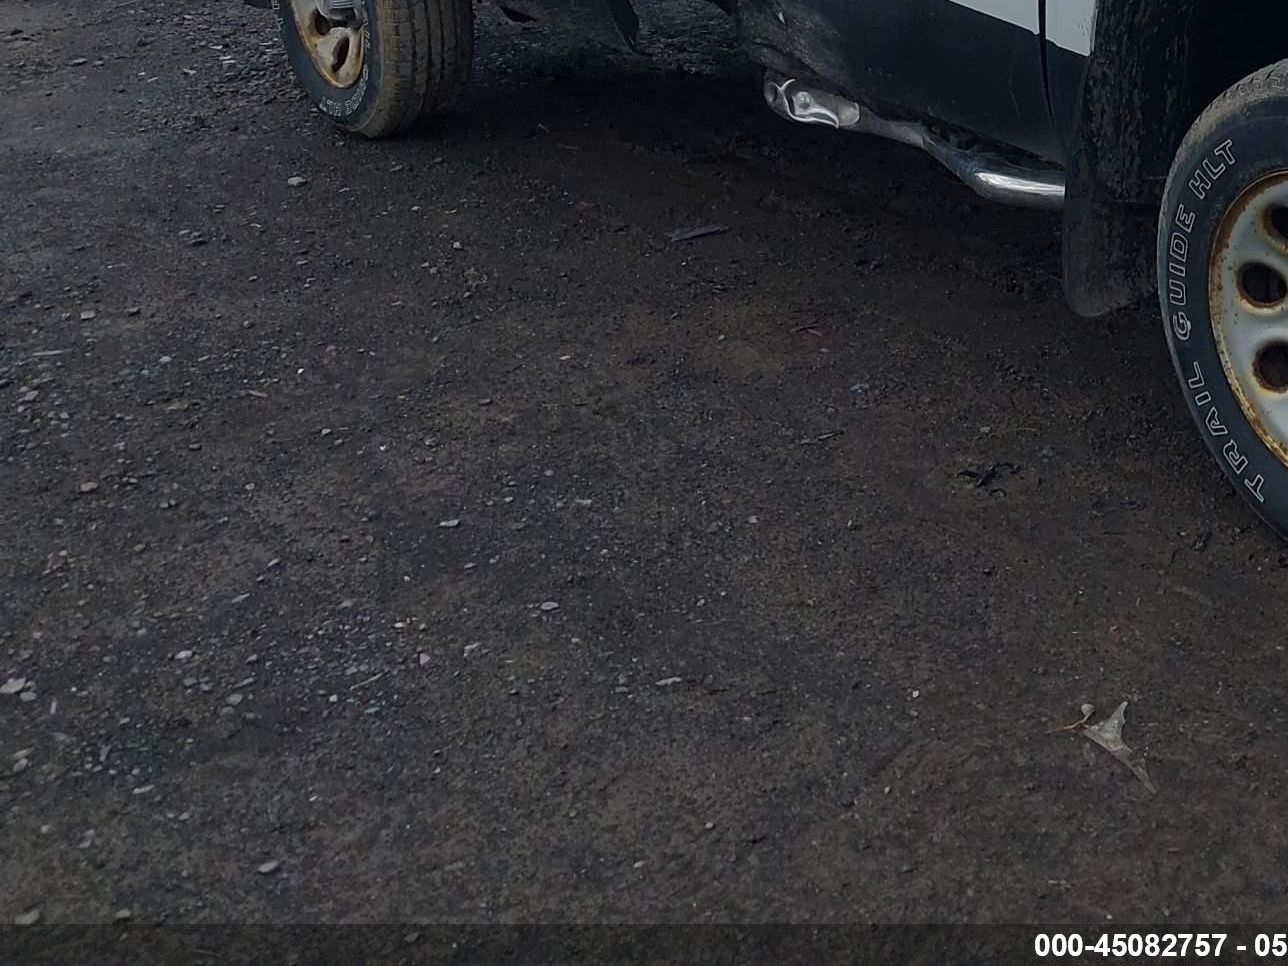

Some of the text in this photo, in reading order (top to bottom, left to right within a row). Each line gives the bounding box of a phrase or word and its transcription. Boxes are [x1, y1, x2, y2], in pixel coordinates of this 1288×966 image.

[1167, 138, 1267, 504] TRAIL GUIDE HLT
